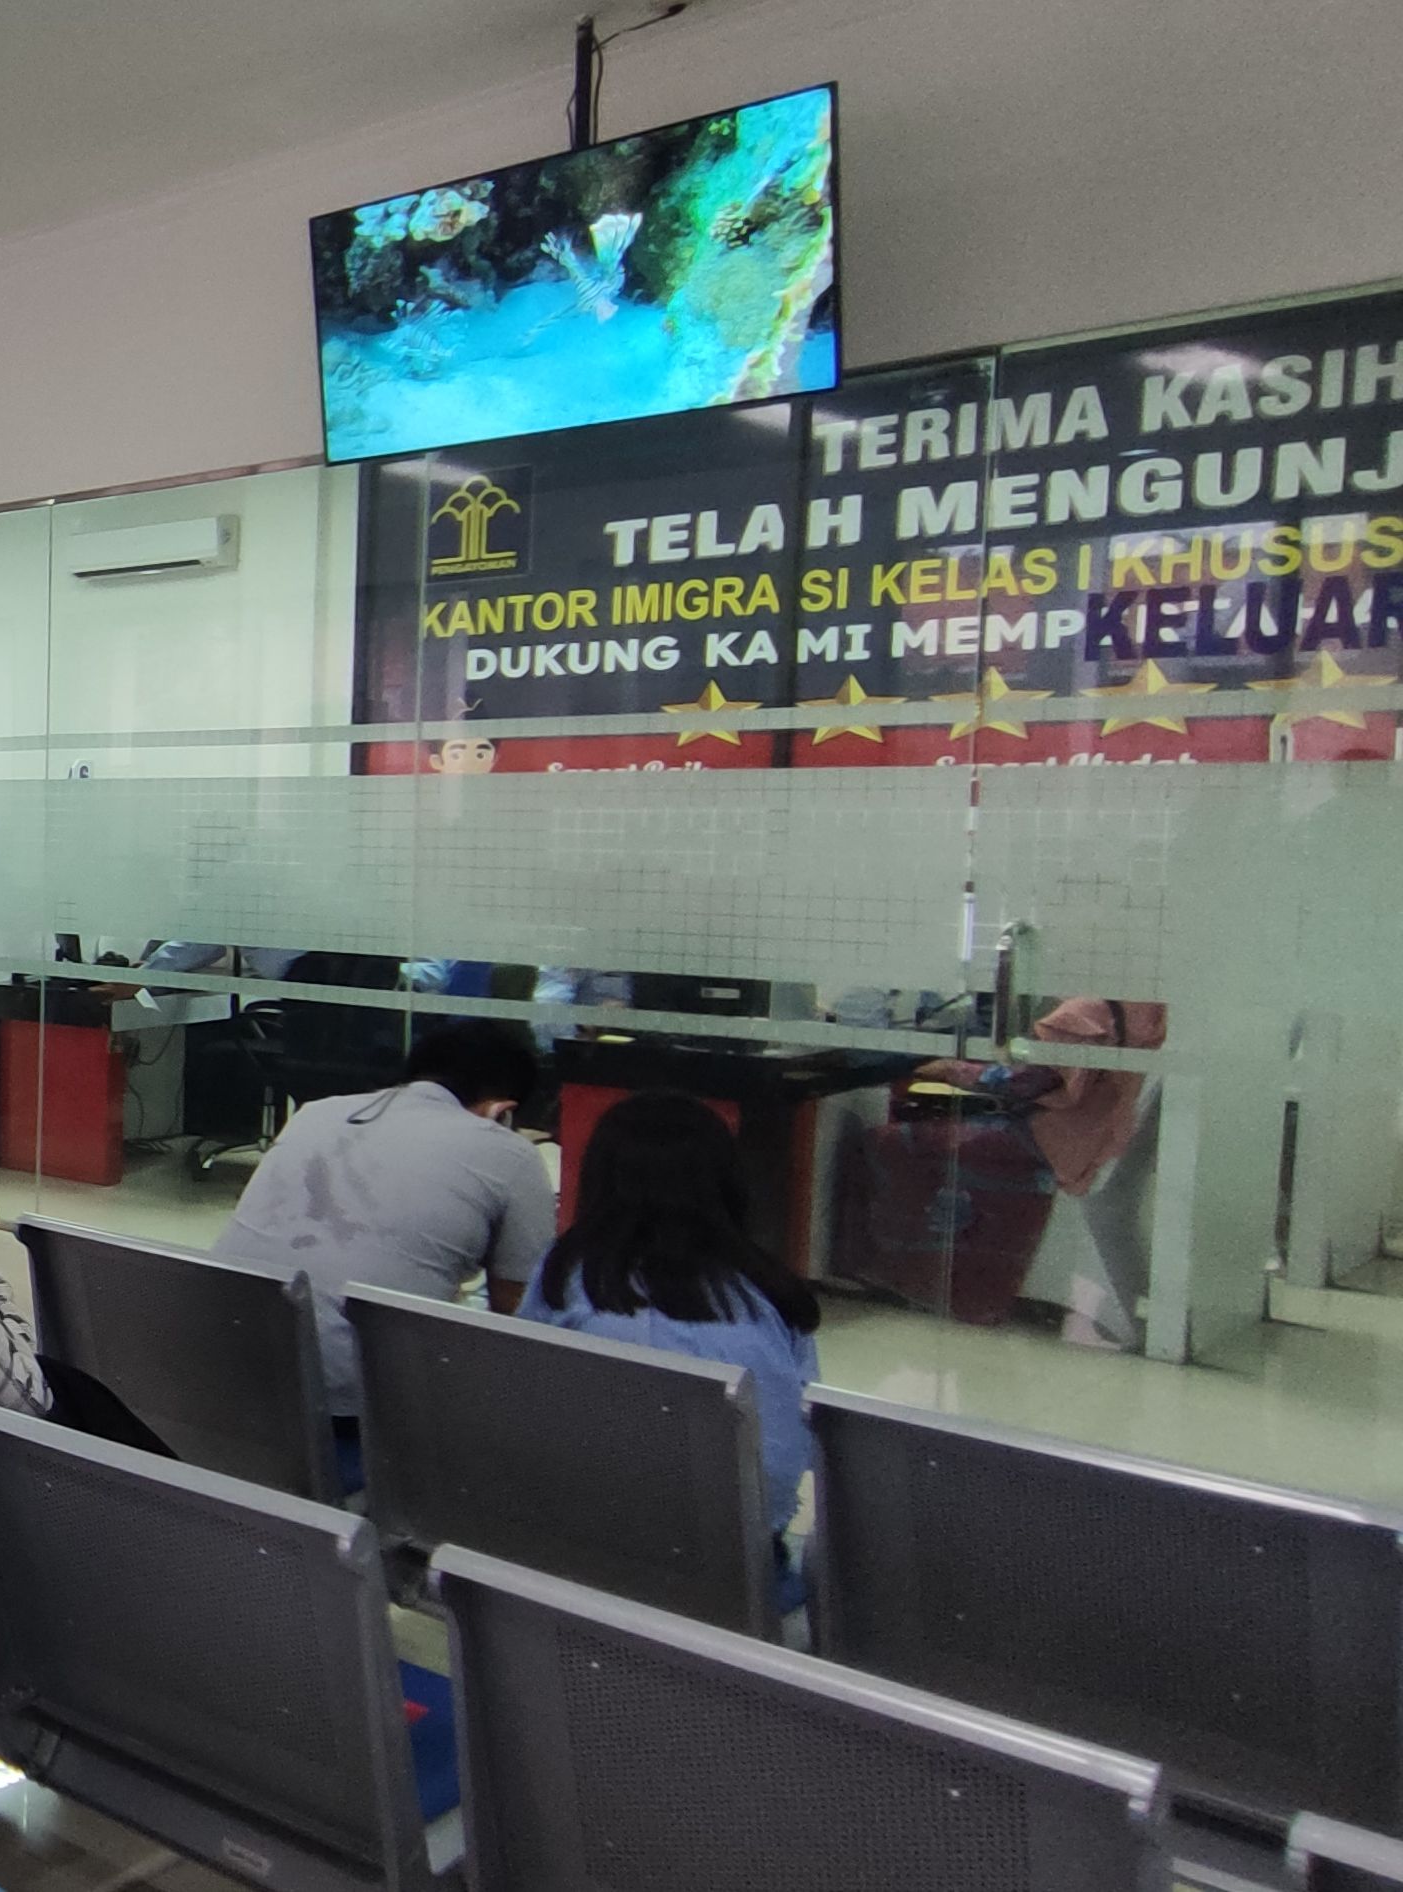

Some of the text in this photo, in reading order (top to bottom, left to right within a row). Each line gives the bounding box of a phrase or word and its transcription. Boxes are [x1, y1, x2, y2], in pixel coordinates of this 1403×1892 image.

[813, 339, 1403, 475] TERIMA KASIH
[897, 430, 1403, 540] MENGUNJ
[423, 588, 598, 639] KANTOR
[870, 548, 1059, 608] KELAS
[1077, 543, 1092, 591] I
[1110, 515, 1403, 589] KHUSUS
[466, 635, 681, 682] DUKUNG
